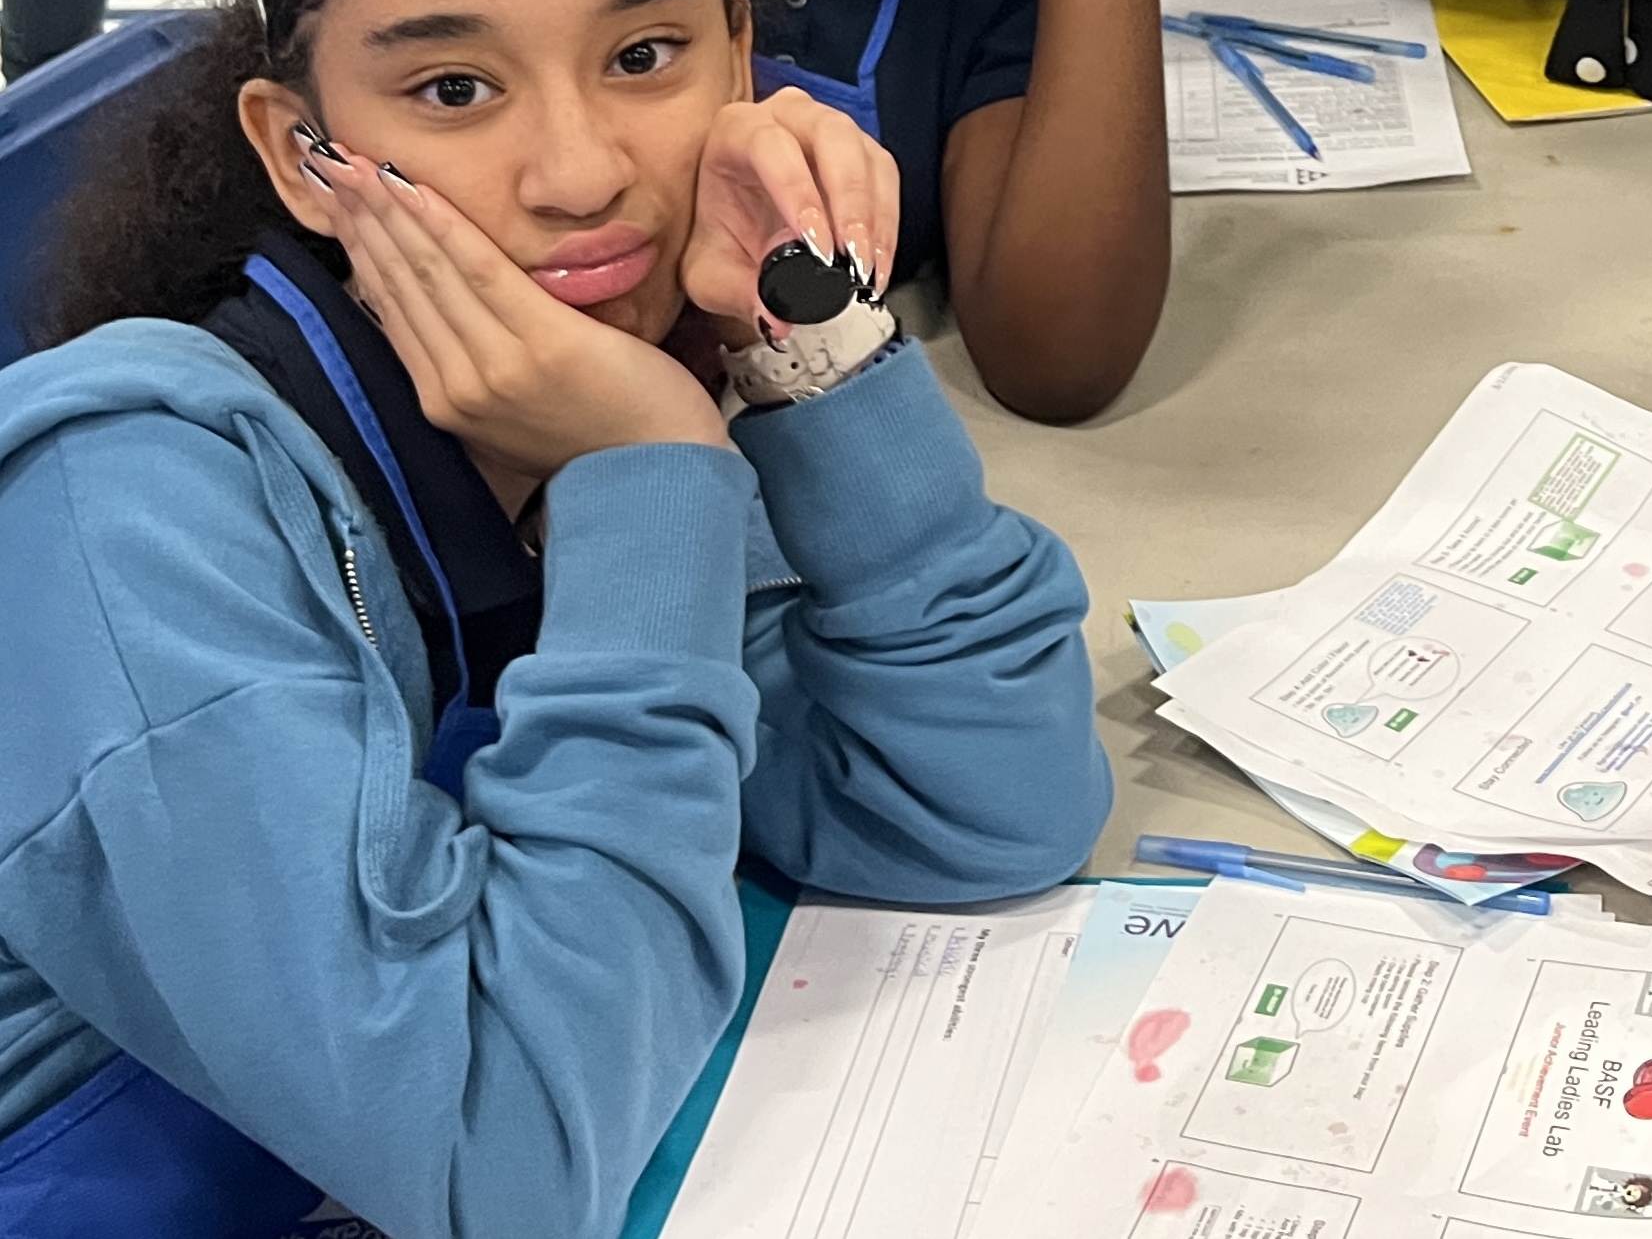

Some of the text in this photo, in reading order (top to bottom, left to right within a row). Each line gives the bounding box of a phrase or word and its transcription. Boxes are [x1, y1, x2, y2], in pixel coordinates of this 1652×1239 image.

[1542, 1001, 1611, 1157] Leading Ladies Lab
[1591, 1059, 1623, 1110] BASF
[1518, 1109, 1538, 1138] Event
